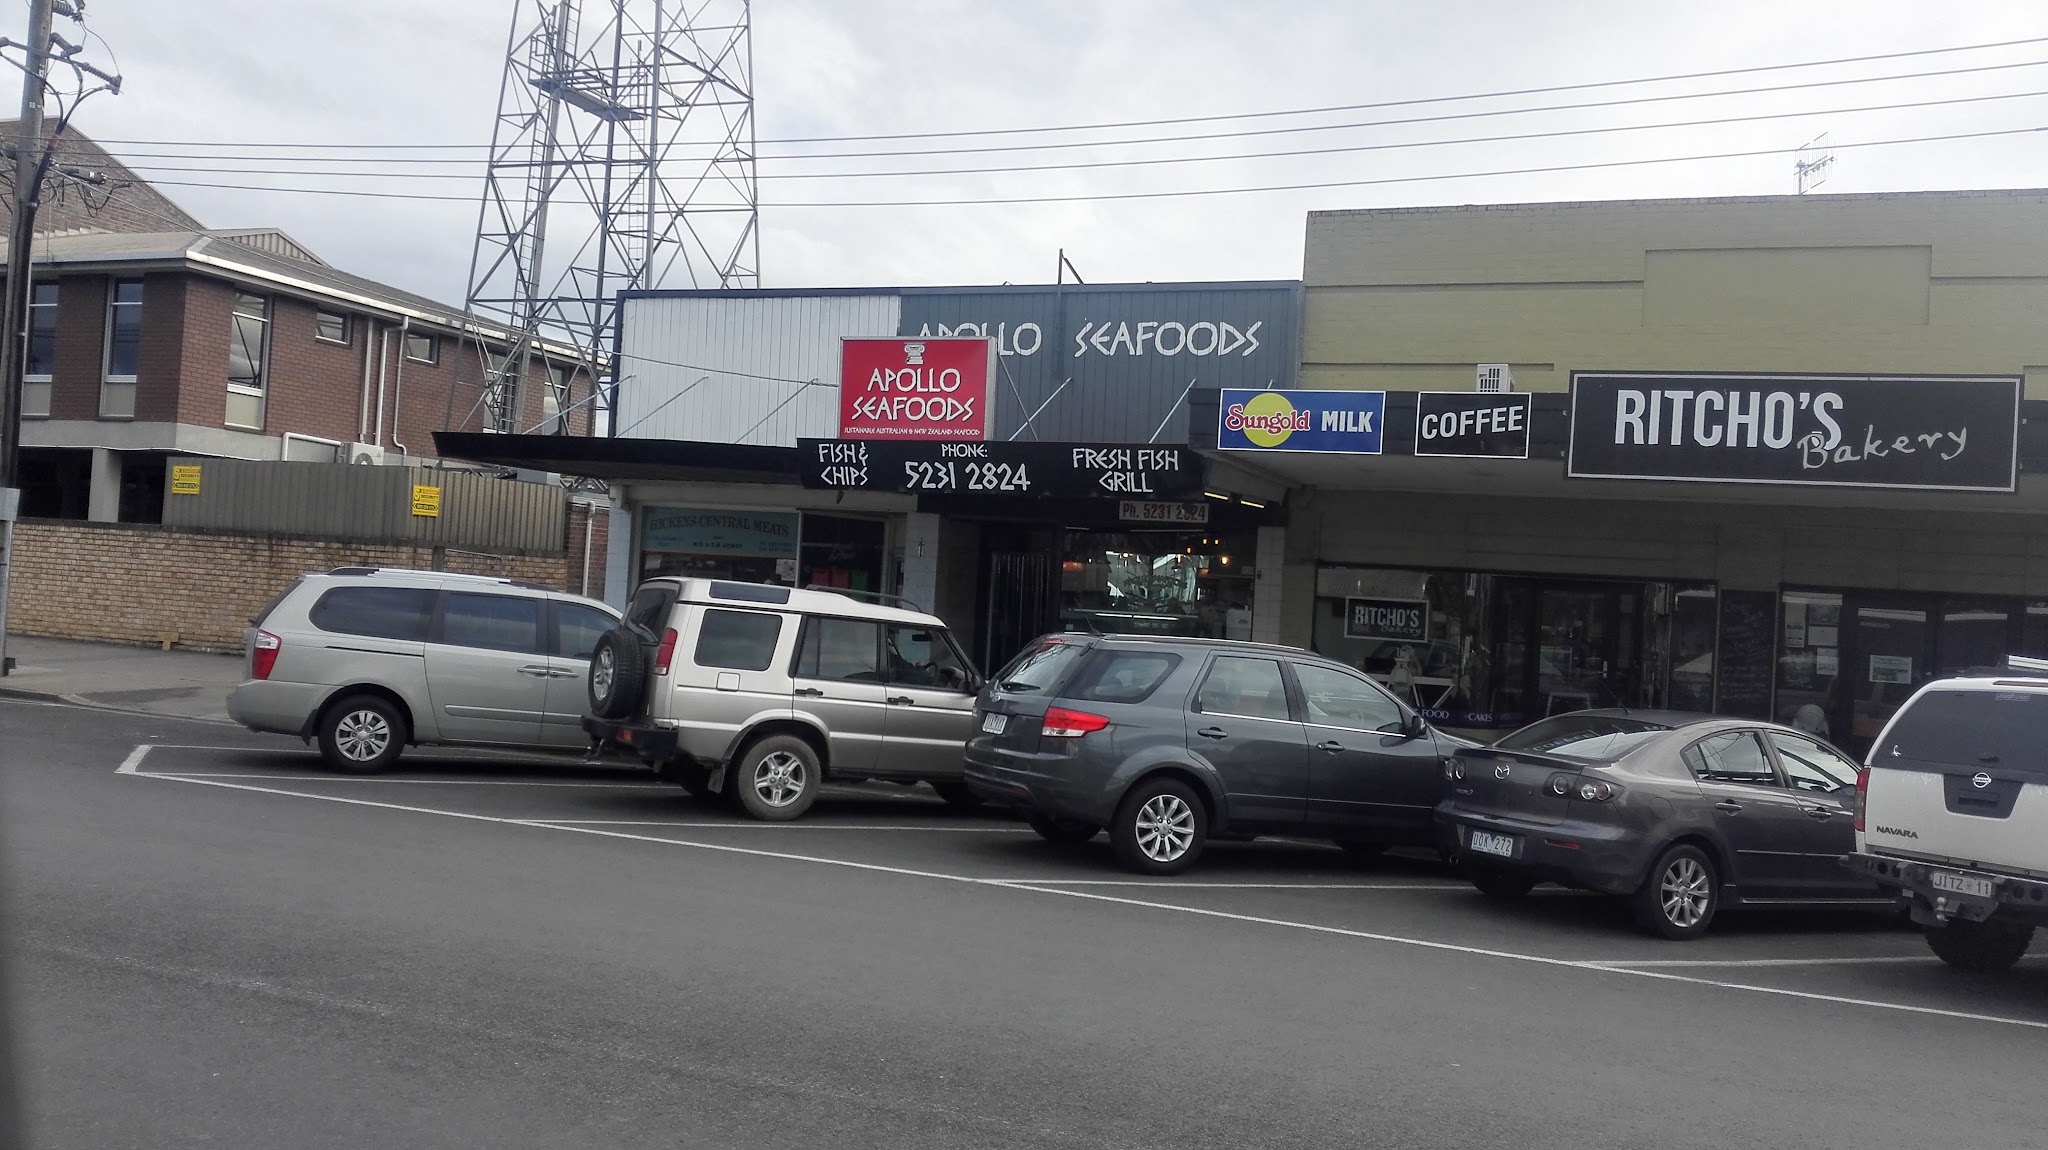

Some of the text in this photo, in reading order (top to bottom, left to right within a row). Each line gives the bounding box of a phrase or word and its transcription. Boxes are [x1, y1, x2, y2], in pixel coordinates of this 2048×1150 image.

[1074, 320, 1263, 357] SEAFOODS
[867, 367, 962, 393] APOLLO
[851, 396, 975, 422] SEAFOODS
[1224, 403, 1373, 436] Sungold MILK
[1614, 389, 1844, 451] RITCHO'S
[1422, 405, 1524, 440] COFFEE
[818, 442, 869, 466] FISH &
[941, 444, 988, 458] PHONE:
[1796, 424, 1967, 470] Bakery
[1072, 448, 1179, 471] FRESH FISH
[820, 466, 869, 486] CHIPS
[905, 461, 1031, 491] 5231 2824
[1099, 471, 1153, 493] GRILL
[1122, 503, 1140, 518] Ph.
[1143, 503, 1171, 520] 5231
[699, 515, 751, 530] CENTRAL
[753, 519, 789, 536] MEATS
[1354, 606, 1420, 628] RITCHO'S
[1421, 708, 1449, 719] FOOD
[1468, 712, 1493, 722] CAKES
[1876, 825, 1919, 839] NAVARA
[1494, 837, 1512, 852] 272
[1976, 880, 1989, 895] 11
